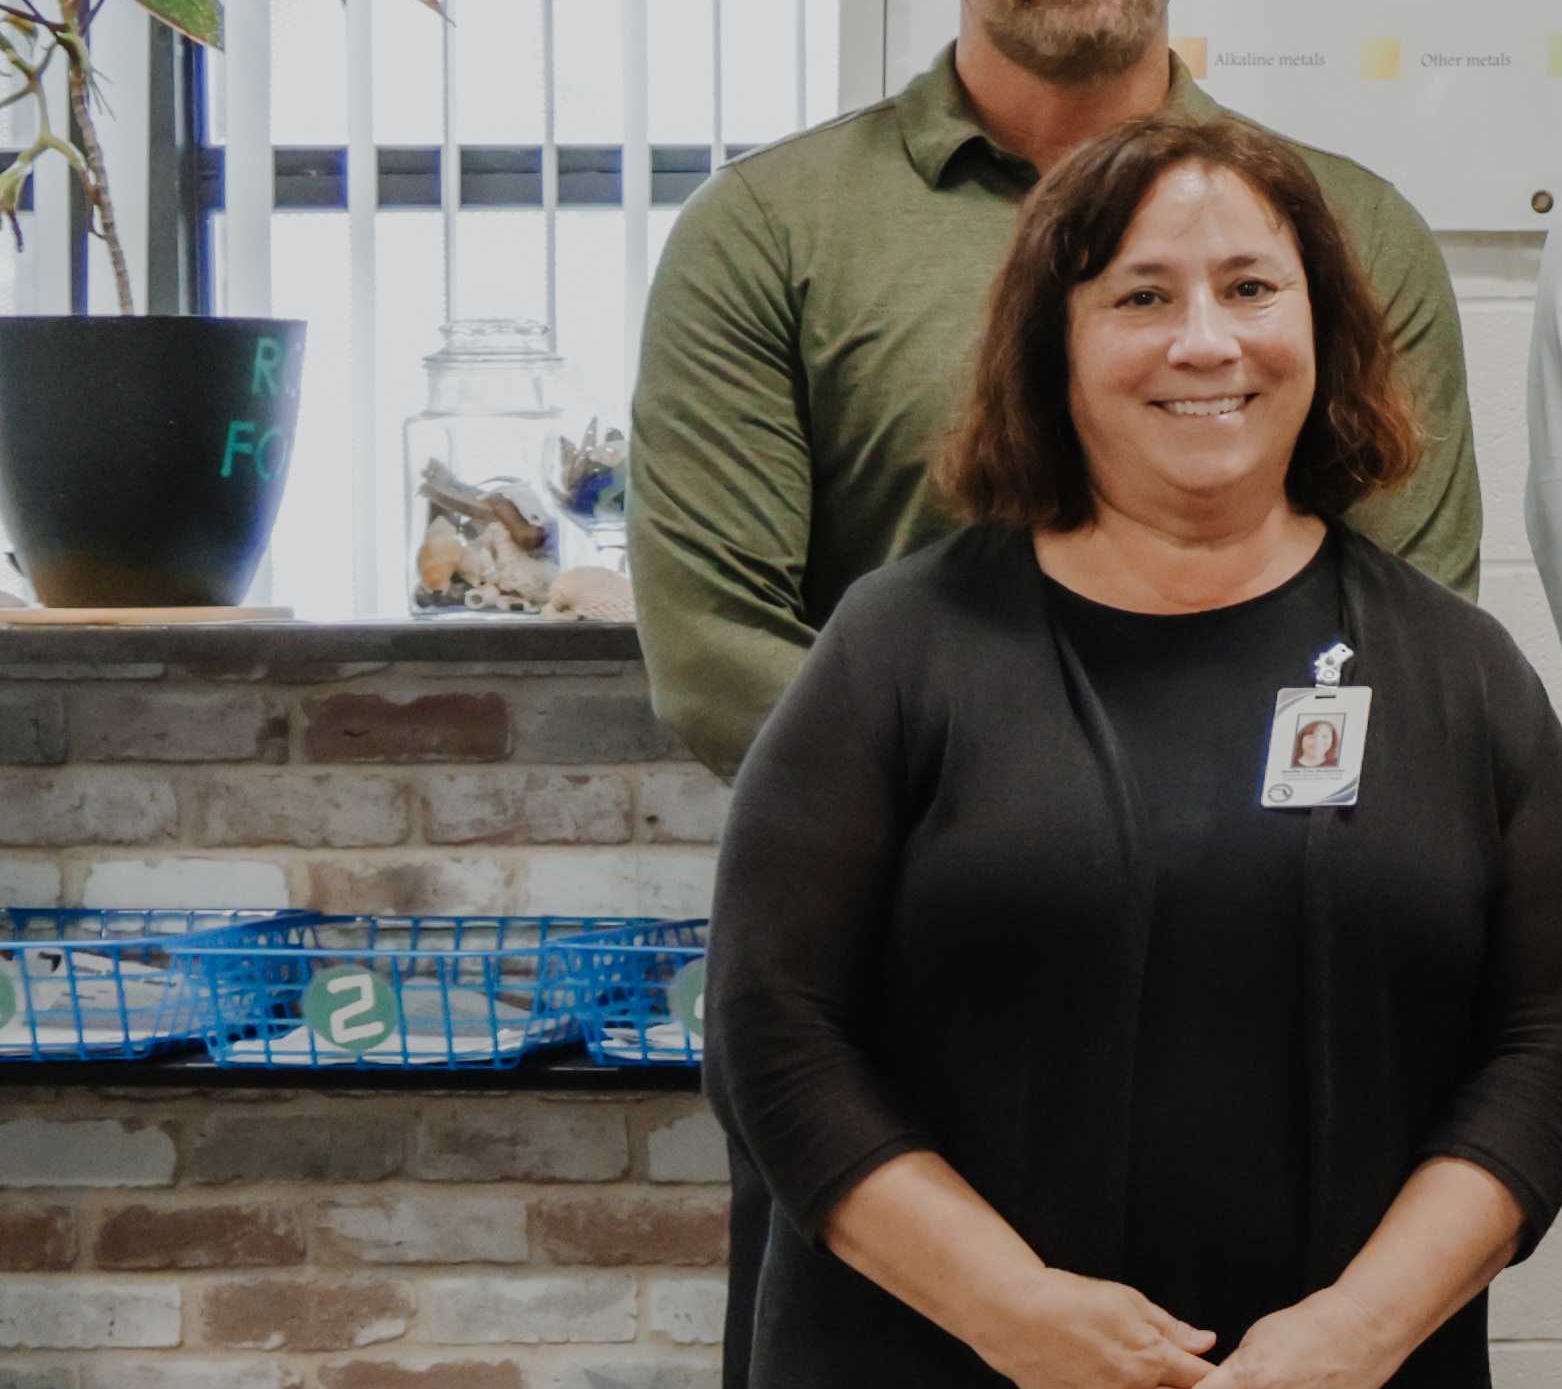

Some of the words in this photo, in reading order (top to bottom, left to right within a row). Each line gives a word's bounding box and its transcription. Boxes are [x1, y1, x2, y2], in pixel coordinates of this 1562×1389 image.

[1214, 52, 1275, 66] Alkaline
[1279, 52, 1326, 66] metals
[1421, 53, 1463, 68] Other
[1466, 53, 1512, 67] metals
[326, 973, 384, 1043] 2
